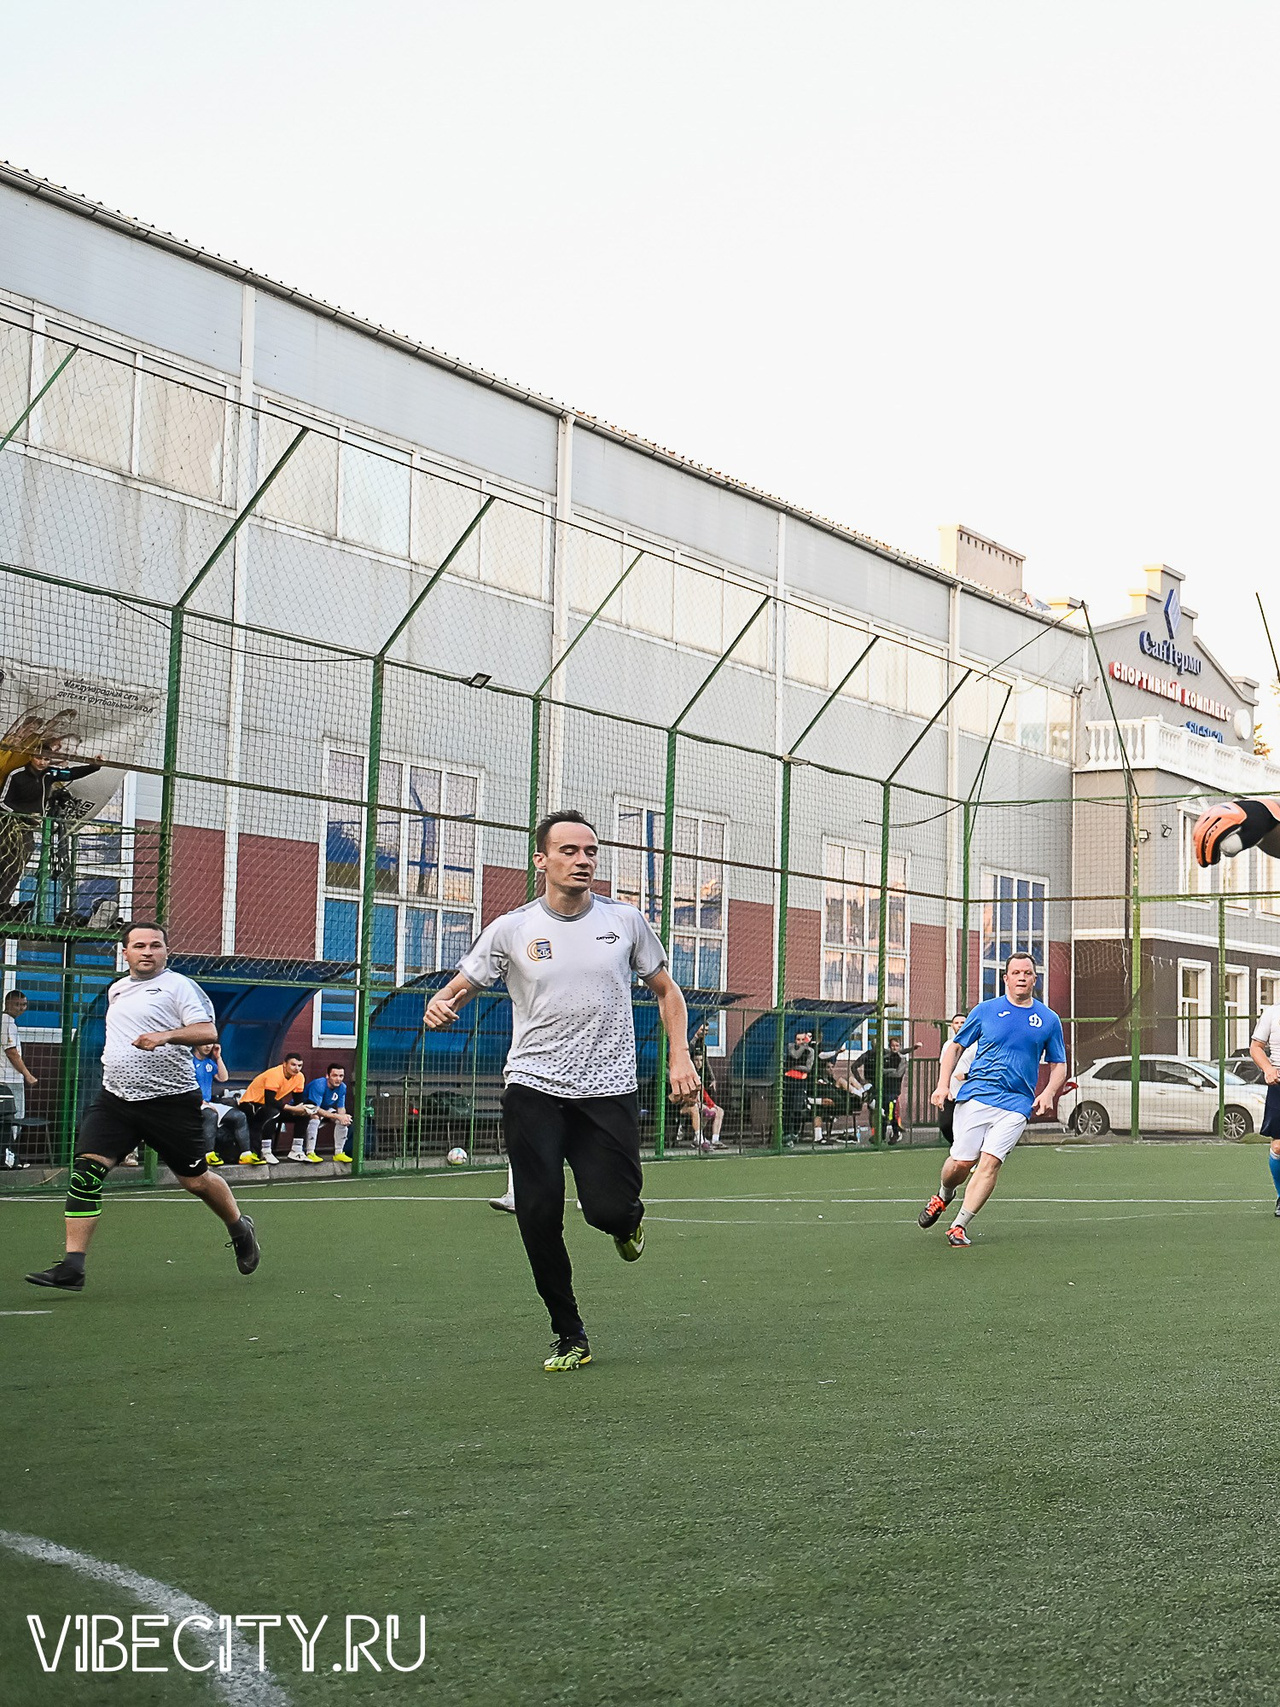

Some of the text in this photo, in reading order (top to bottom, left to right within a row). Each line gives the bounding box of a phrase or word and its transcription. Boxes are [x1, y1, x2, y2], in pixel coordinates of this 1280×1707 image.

[1139, 630, 1202, 675] СанТермо
[1109, 661, 1232, 722] СПОРТИВНЫЙ КОМПЛЕКС
